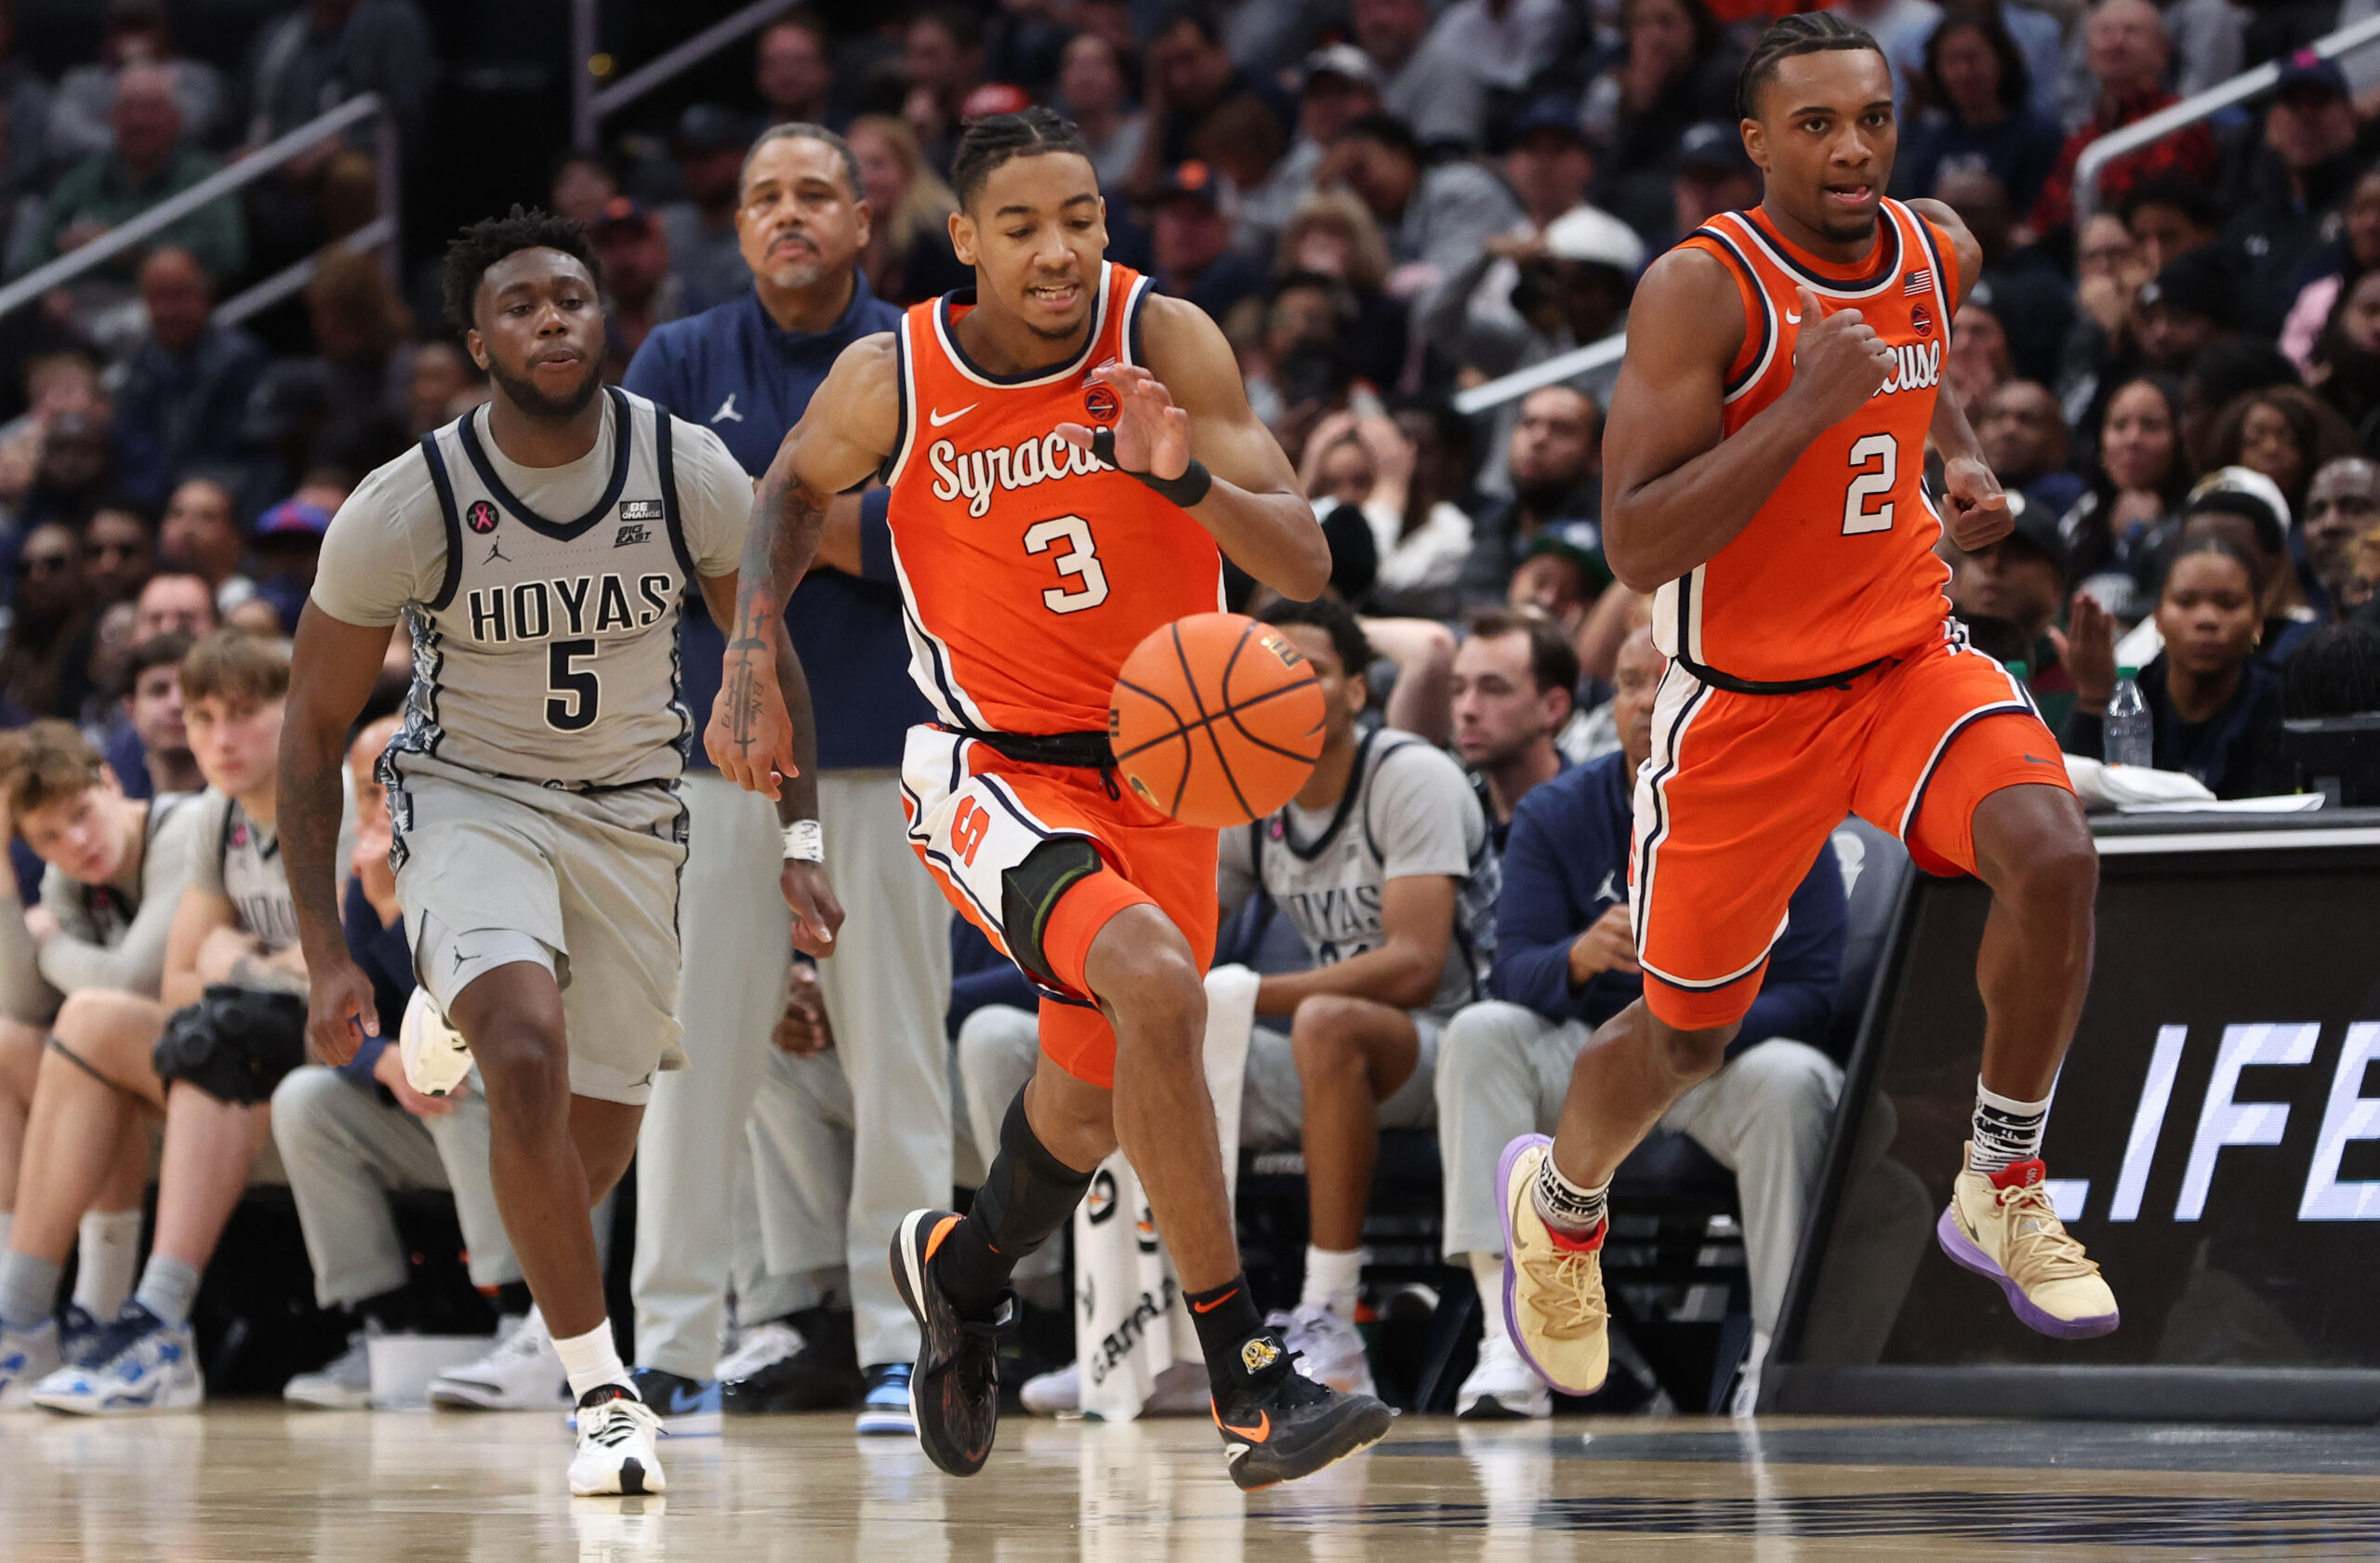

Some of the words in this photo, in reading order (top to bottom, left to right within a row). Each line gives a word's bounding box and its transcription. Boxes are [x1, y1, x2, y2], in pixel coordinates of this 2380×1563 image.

[629, 502, 648, 512] BE
[1841, 431, 1898, 536] 2
[615, 531, 653, 545] EAST
[617, 523, 644, 536] BIG
[1023, 513, 1110, 615] 3
[468, 573, 672, 643] HOYAS
[544, 638, 602, 734] 5
